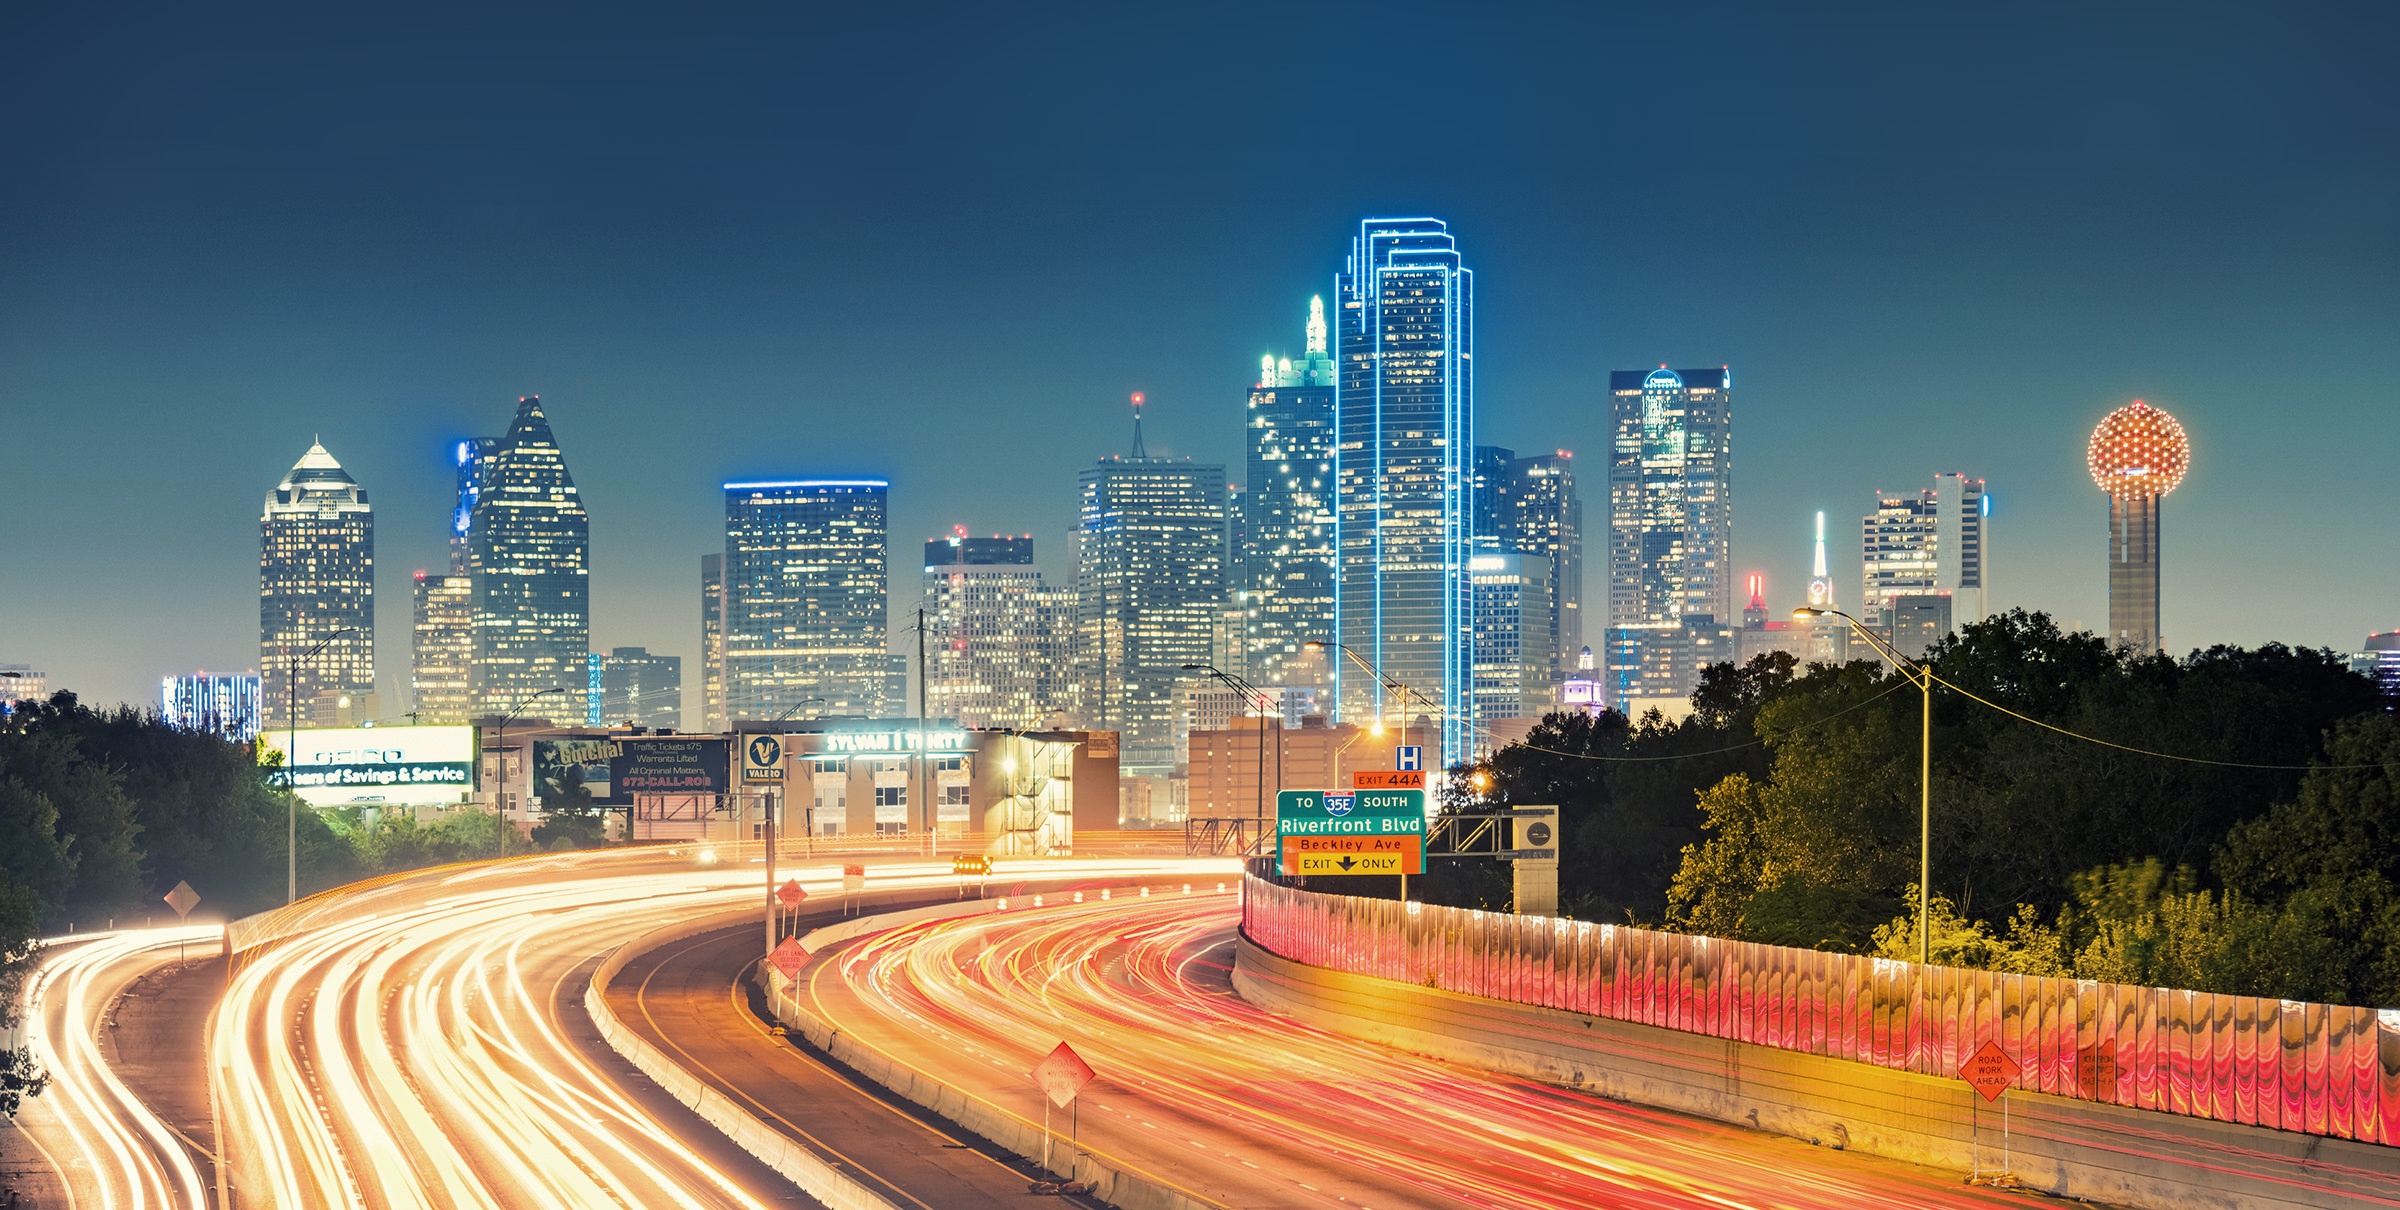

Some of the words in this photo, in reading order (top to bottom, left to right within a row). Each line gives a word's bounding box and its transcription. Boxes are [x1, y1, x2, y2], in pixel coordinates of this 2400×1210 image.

[632, 742, 657, 751] Traffic
[658, 742, 685, 751] Tickets
[686, 742, 702, 751] $75
[827, 734, 889, 750] SYLVAN
[313, 748, 406, 766] GEICO
[560, 741, 624, 764] Gotcha!
[636, 754, 676, 763] Warrants
[676, 754, 698, 763] Lifted
[1400, 747, 1418, 770] H
[325, 768, 342, 784] of
[342, 768, 396, 784] Savings
[398, 767, 411, 782] &
[412, 766, 465, 782] Service
[628, 766, 638, 774] All
[640, 766, 672, 774] Criminal
[673, 766, 705, 774] Matters
[748, 769, 781, 778] VALERO
[622, 776, 712, 787] 972-CALL-ROB
[1359, 776, 1383, 785] EXIT
[1388, 774, 1422, 786] 44A
[1296, 798, 1314, 808] TO
[1327, 798, 1350, 811] 35E
[1363, 796, 1408, 808] SOUTH
[1281, 818, 1372, 833] Riverfront
[1382, 818, 1420, 832] Blvd
[1301, 839, 1364, 851] Beckley
[1374, 840, 1401, 850] Ave
[1304, 858, 1332, 869] EXIT
[1362, 858, 1396, 869] ONLY
[1051, 1059, 1076, 1067] ROAD
[1978, 1056, 2002, 1064] ROAD
[1050, 1070, 1076, 1078] WORK
[1048, 1082, 1078, 1090] AHEAD
[1976, 1078, 2006, 1086] AHEAD
